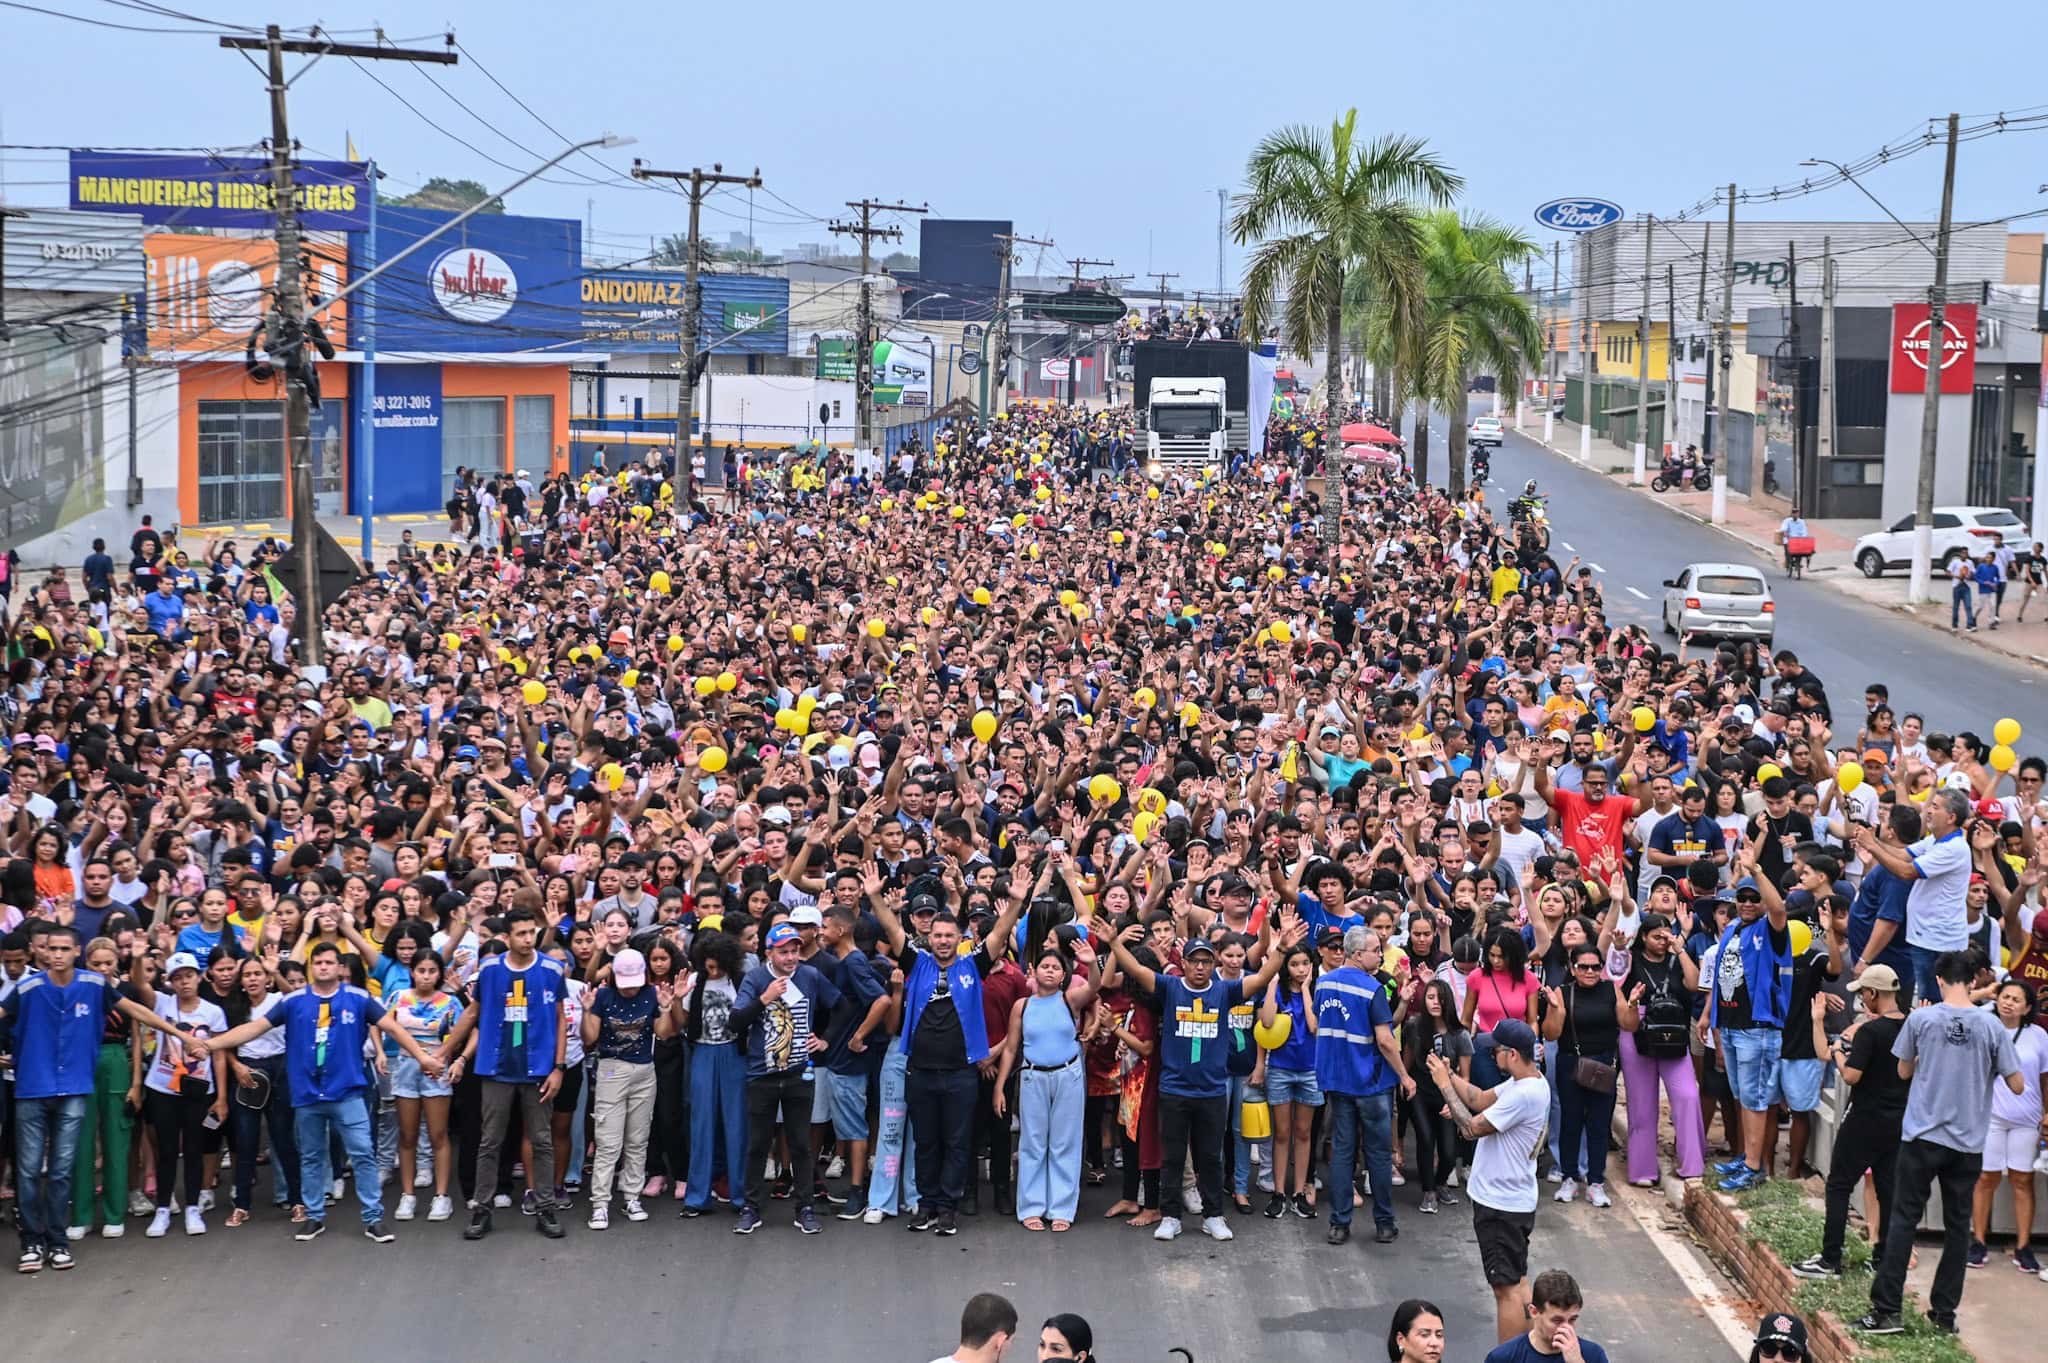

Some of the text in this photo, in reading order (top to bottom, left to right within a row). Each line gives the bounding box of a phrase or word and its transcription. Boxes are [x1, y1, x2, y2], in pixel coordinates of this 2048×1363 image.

[78, 176, 356, 211] MANGUEIRAS HIDRLICAS
[1552, 203, 1608, 225] Ford
[581, 278, 684, 305] ONDOMAZ
[1902, 340, 1968, 349] NISAN
[386, 395, 431, 409] 3221-2015
